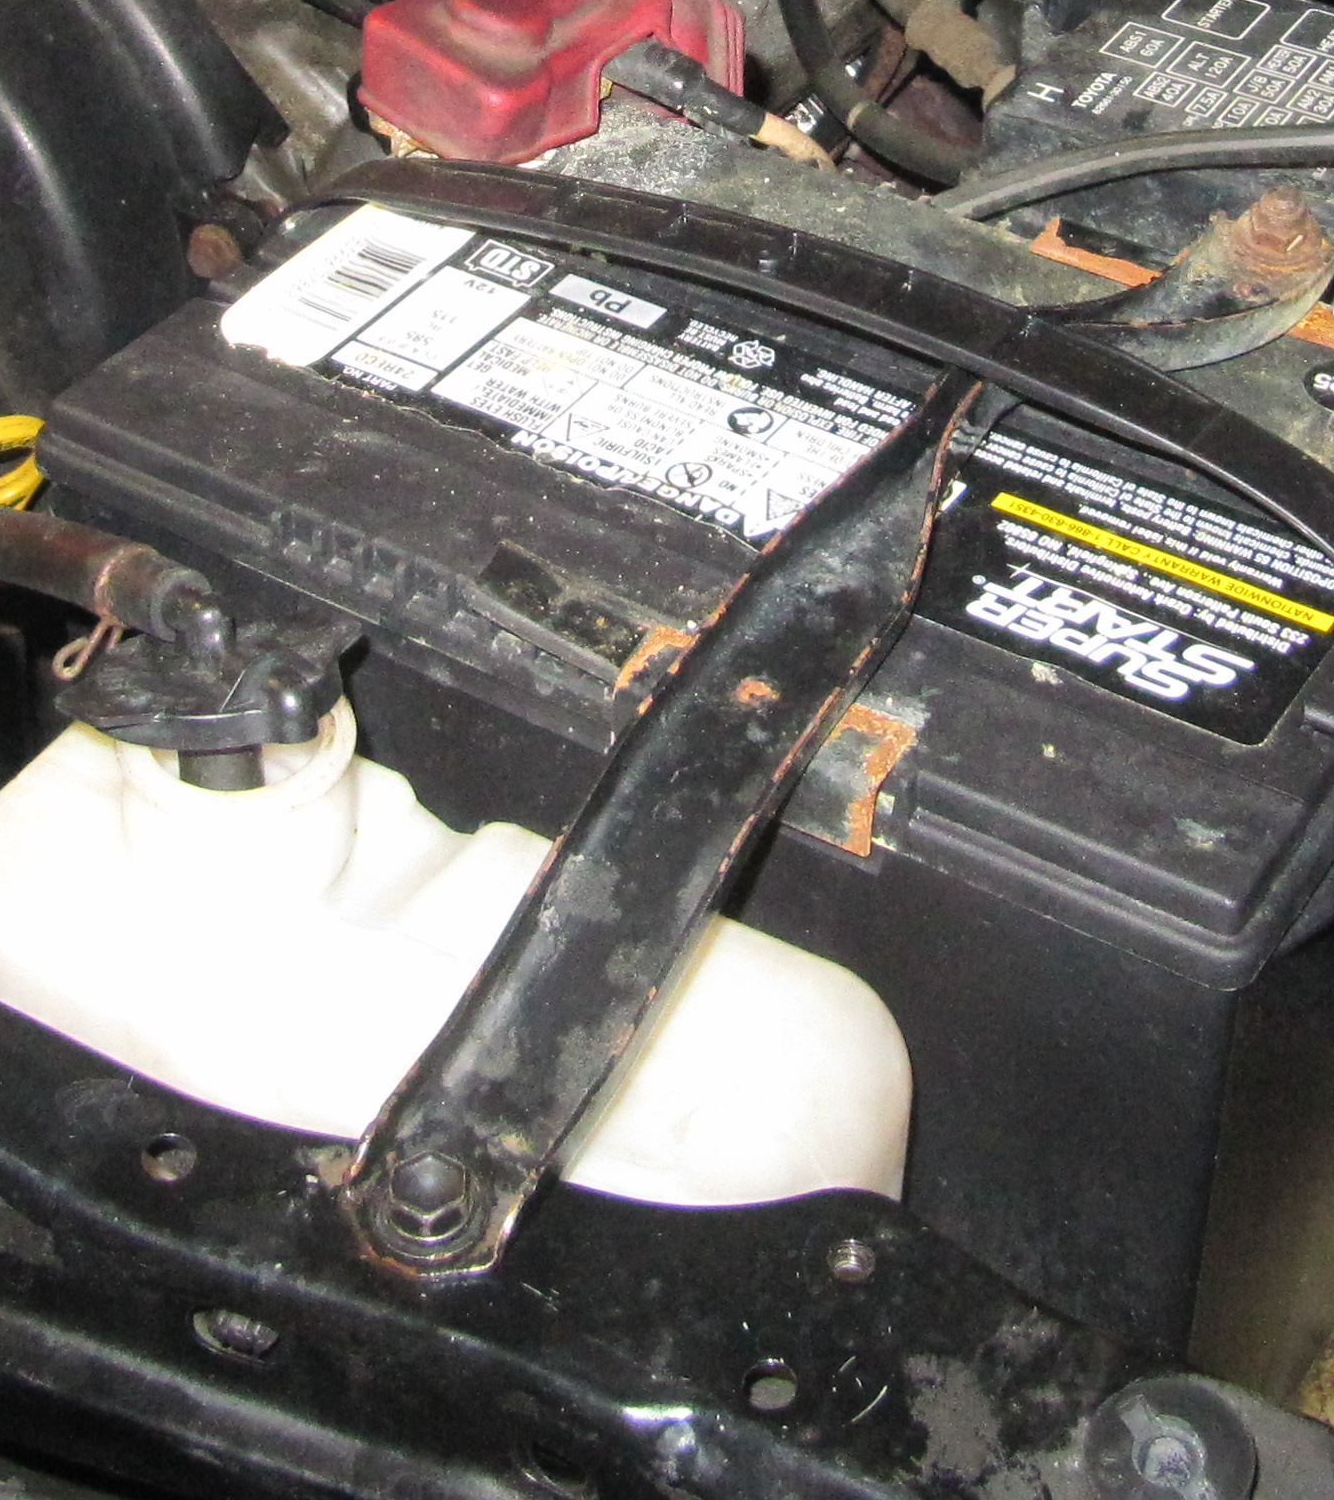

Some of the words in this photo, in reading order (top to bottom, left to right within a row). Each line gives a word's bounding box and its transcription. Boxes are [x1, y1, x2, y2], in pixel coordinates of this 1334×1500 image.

[1118, 30, 1147, 53] ABS1
[1139, 38, 1165, 57] 60A
[1186, 53, 1210, 71] ALT
[1204, 55, 1233, 78] 120A
[1282, 54, 1308, 73] 50A
[1027, 82, 1065, 102] H
[1071, 69, 1118, 109] TOYOTA
[1141, 75, 1170, 98] ABS2
[1159, 82, 1186, 101] 40A
[1243, 74, 1268, 93] J/B
[1260, 78, 1286, 98] 50A
[1193, 91, 1221, 112] 7.5A
[1295, 88, 1322, 109] AM2
[1226, 101, 1252, 120] 10A
[476, 246, 543, 281] STD
[461, 278, 498, 294] 12V
[581, 287, 634, 313] Pb
[674, 332, 722, 352] BATTERY
[339, 365, 364, 378] NO.
[465, 359, 492, 373] GET
[474, 350, 532, 376] MEDICAL
[363, 374, 398, 391] PART
[483, 377, 529, 398] WATER
[646, 374, 727, 407] INSTRUCTIONS
[810, 367, 875, 396] HANDLING.
[468, 395, 504, 413] EYES
[526, 394, 563, 412] WITH
[871, 390, 913, 409] AFTER
[500, 409, 544, 430] FLUSH
[770, 402, 837, 429] EXPLOSION
[591, 436, 657, 465] SULFURIC
[632, 437, 666, 455] ACID
[986, 442, 1024, 460] cancer
[1025, 444, 1058, 462] cause
[1004, 460, 1043, 480] related
[1021, 455, 1054, 473] cause
[1070, 461, 1124, 487] California
[508, 428, 747, 526] DANGER/POISON
[717, 479, 739, 491] NO
[1041, 473, 1064, 488] and
[1066, 471, 1119, 497] California
[1063, 481, 1117, 507] terminals
[1131, 495, 1163, 513] State
[1136, 485, 1166, 503] State
[1166, 497, 1185, 509] the
[1075, 503, 1132, 530] removed.
[1162, 506, 1183, 520] the
[1197, 508, 1235, 528] known
[1131, 524, 1164, 543] label
[1149, 513, 1192, 536] Battery
[1194, 519, 1233, 539] known
[1037, 534, 1064, 551] MO
[1163, 536, 1188, 552] this
[1191, 528, 1253, 558] WARNING:
[1234, 522, 1293, 549] chemicals
[1103, 536, 1141, 556] CALL
[1232, 533, 1290, 560] chemicals
[1293, 543, 1324, 561] other
[1198, 549, 1227, 566] void
[1253, 552, 1272, 565] 65
[1142, 550, 1222, 586] WARRANTY
[1226, 558, 1285, 588] Warranty
[1078, 563, 1155, 601] Automotive
[1152, 592, 1193, 614] Ozark
[1174, 585, 1240, 619] Patterson
[1224, 581, 1313, 620] NATIONWIDE
[1191, 605, 1217, 624] by:
[1237, 610, 1281, 634] South
[971, 579, 1255, 686] START
[1214, 616, 1291, 653] Distributed
[1278, 626, 1311, 645] 233
[966, 597, 1191, 700] SUPER
